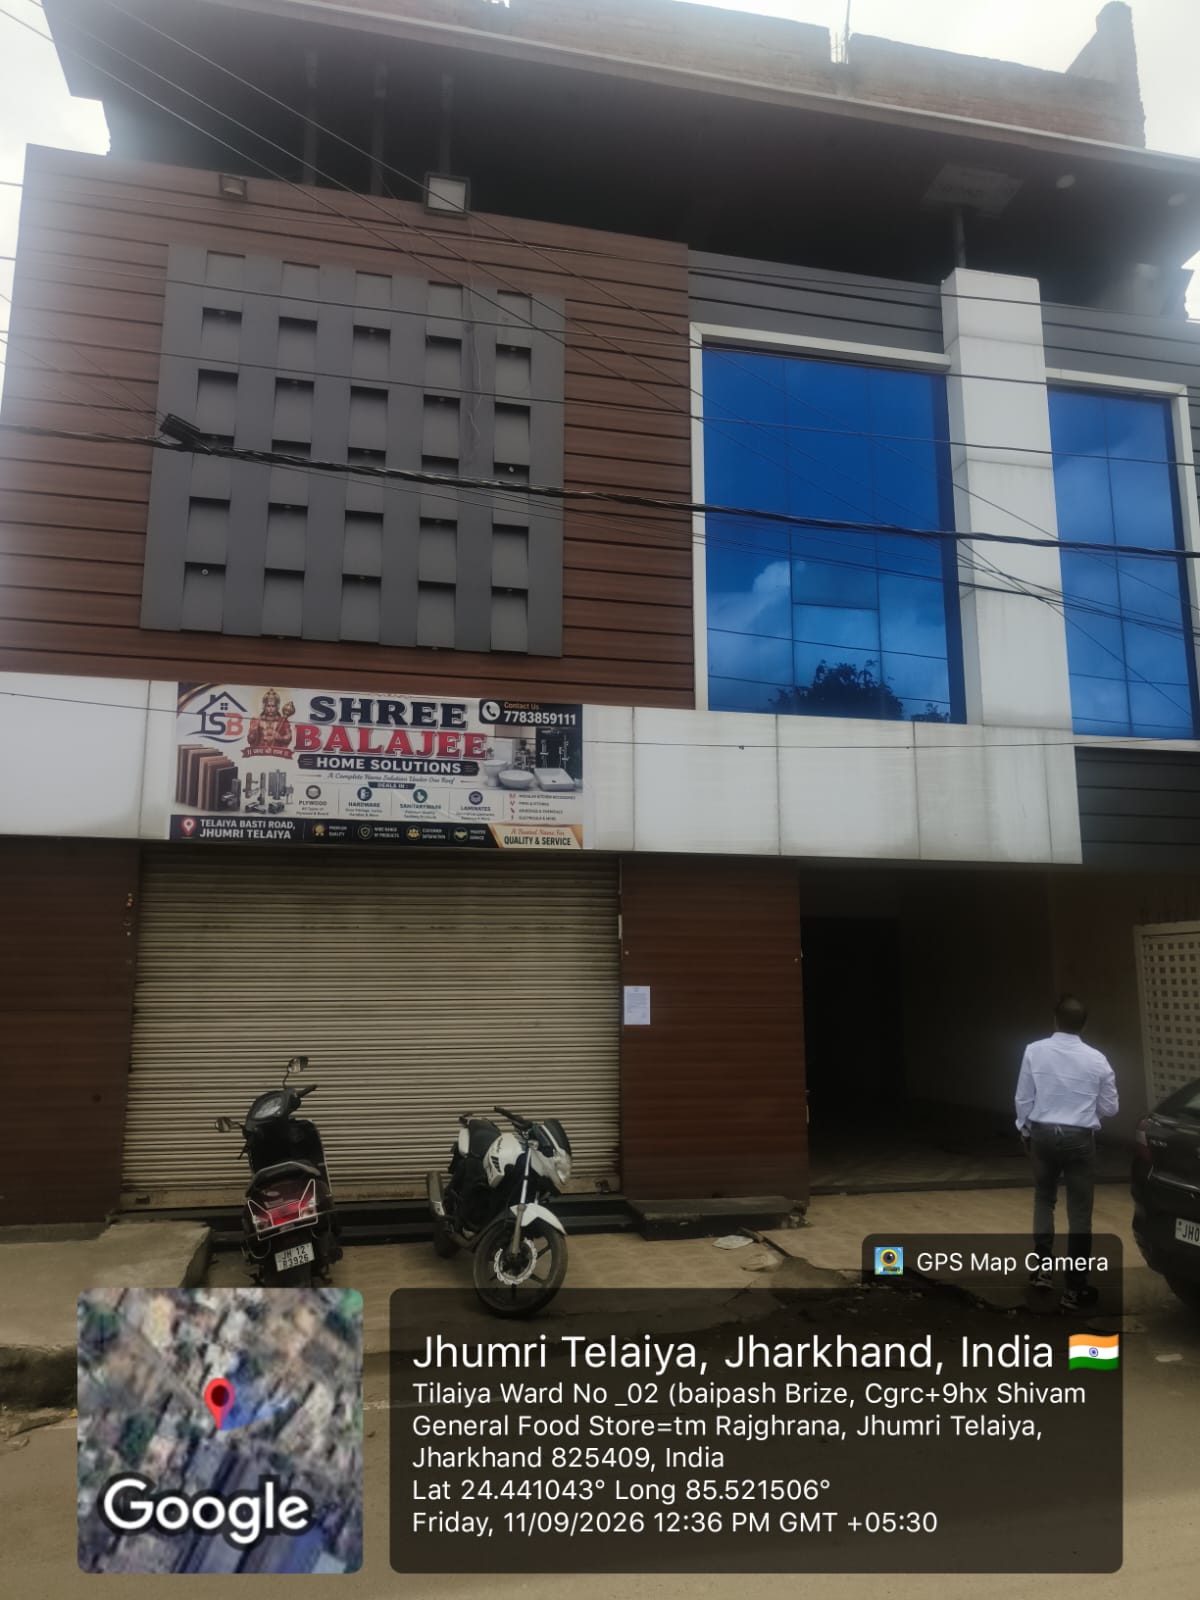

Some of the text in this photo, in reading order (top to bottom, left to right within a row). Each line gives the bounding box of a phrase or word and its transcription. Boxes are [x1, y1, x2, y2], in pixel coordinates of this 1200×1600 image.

[504, 701, 529, 710] Contact
[310, 696, 467, 729] SHREE
[504, 710, 576, 725] 7783859111
[294, 724, 487, 759] BALAJEE
[317, 757, 462, 774] HOME SOLUTIONS
[200, 819, 295, 830] TELAIYA BASTI ROAD,
[200, 829, 291, 839] JHUMRI TELAIYA
[504, 835, 573, 846] QUALITY & SERVICE
[296, 1246, 306, 1255] 12
